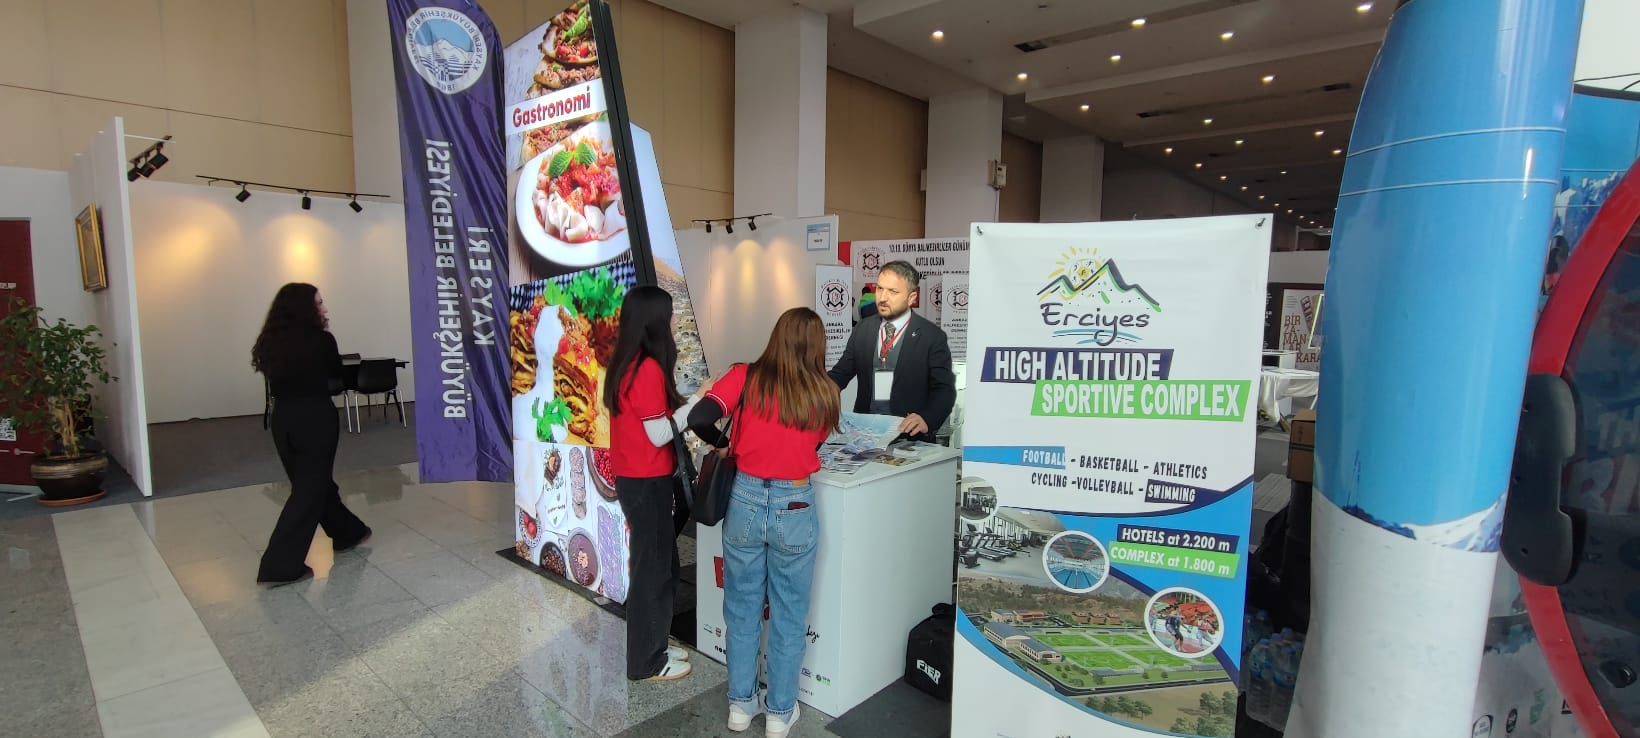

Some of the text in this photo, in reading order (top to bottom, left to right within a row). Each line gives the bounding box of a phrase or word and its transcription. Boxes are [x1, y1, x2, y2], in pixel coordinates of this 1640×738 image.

[513, 85, 591, 127] Gastronomi
[1039, 302, 1150, 346] Erciyes
[995, 350, 1161, 381] HIGH ALTITUDE
[1041, 383, 1240, 417] SPORTIVE COMPLEX
[1023, 450, 1065, 466] FOOTBALL
[1080, 455, 1138, 473] BASKETBALL
[1153, 461, 1207, 479] ATHLETICS
[1031, 472, 1067, 487] CYCLING
[1147, 484, 1196, 502] SWIMMING
[1122, 527, 1230, 552] HOTELS at 2.200 m
[1110, 546, 1230, 576] COMPLEX at 1.800 m
